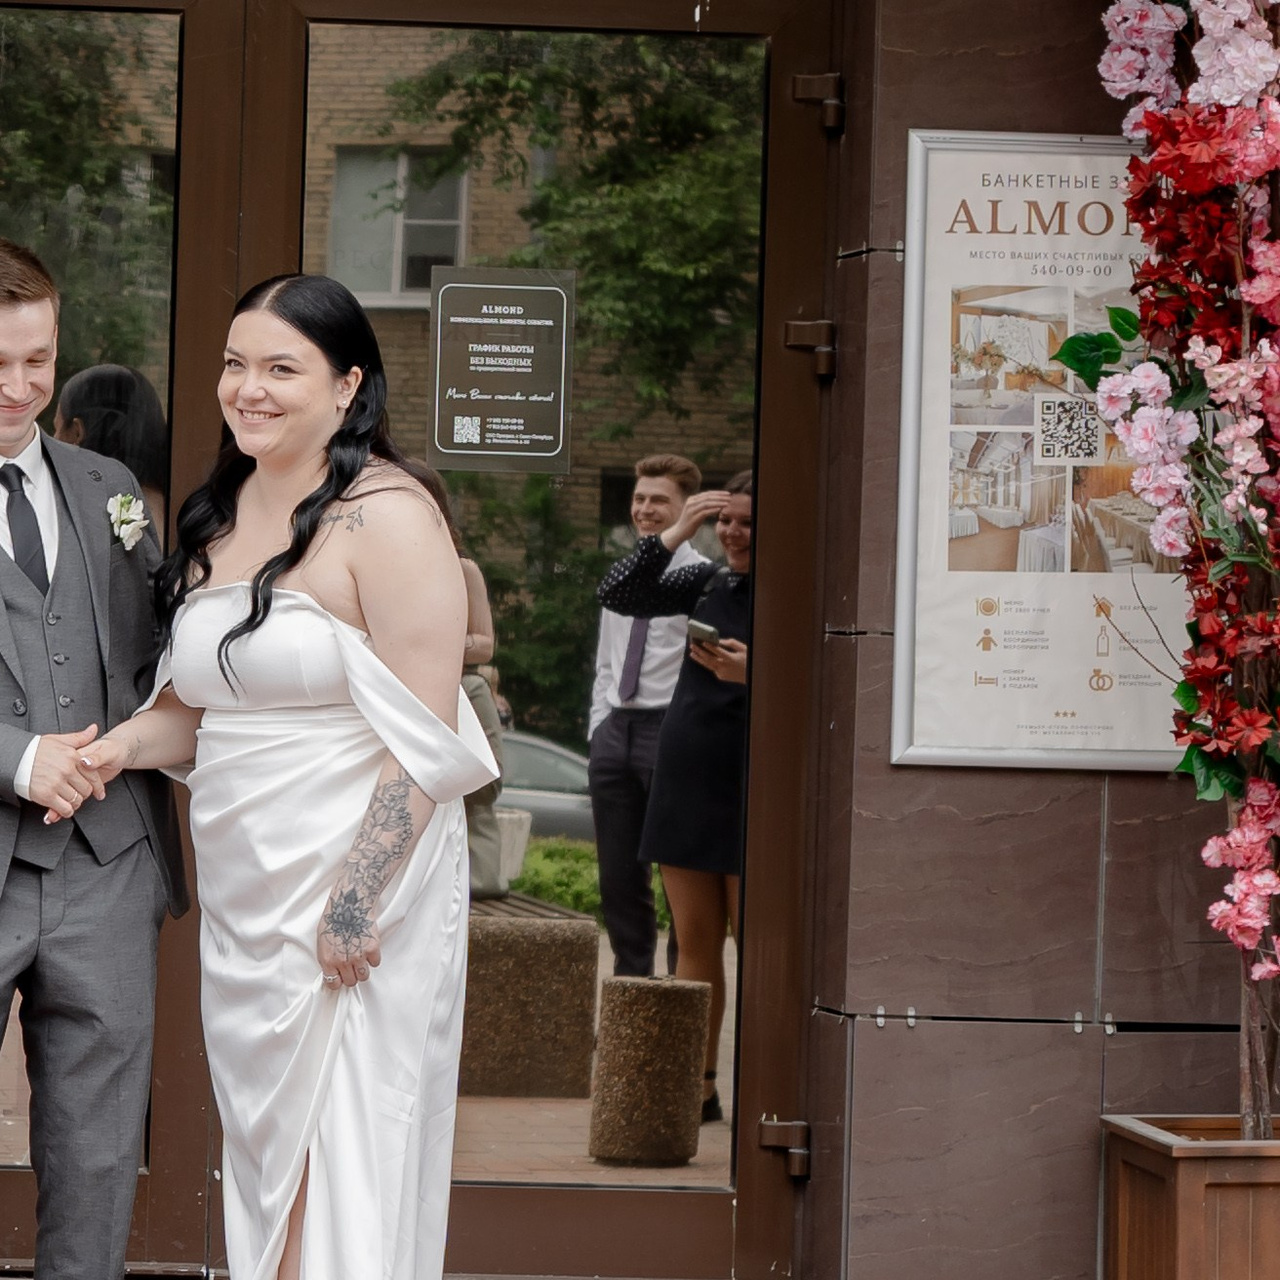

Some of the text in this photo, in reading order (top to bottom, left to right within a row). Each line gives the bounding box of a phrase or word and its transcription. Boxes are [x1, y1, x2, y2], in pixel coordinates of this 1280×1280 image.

[981, 173, 1101, 189] БАНКЕТНЫЕ
[970, 251, 1006, 260] МЕСТО
[1010, 251, 1049, 261] ВАШИХ
[1052, 253, 1123, 261] СЧАСТЛИВЫХ
[1030, 264, 1112, 276] 540-09-00
[481, 305, 524, 315] ALMOND
[468, 344, 534, 353] ГРАФИК РАБОТЫ
[470, 356, 532, 366] БЕЗ ВЫХОДНЫХ
